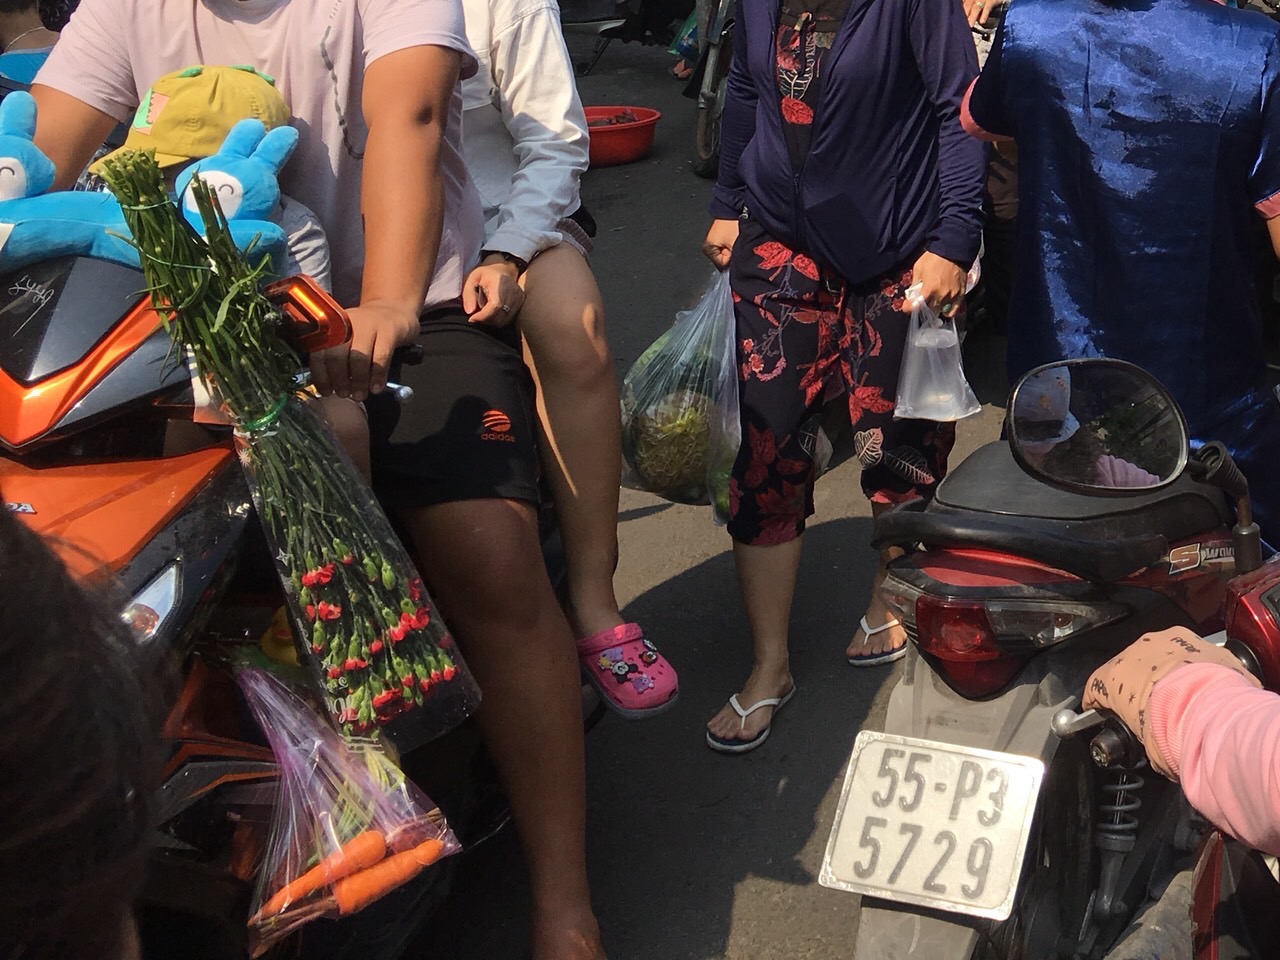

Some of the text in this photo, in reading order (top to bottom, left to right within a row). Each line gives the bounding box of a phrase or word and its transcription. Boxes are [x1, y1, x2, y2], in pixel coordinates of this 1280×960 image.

[481, 431, 516, 443] adidas
[872, 747, 1010, 828] 55-P3
[853, 815, 994, 900] 5729
